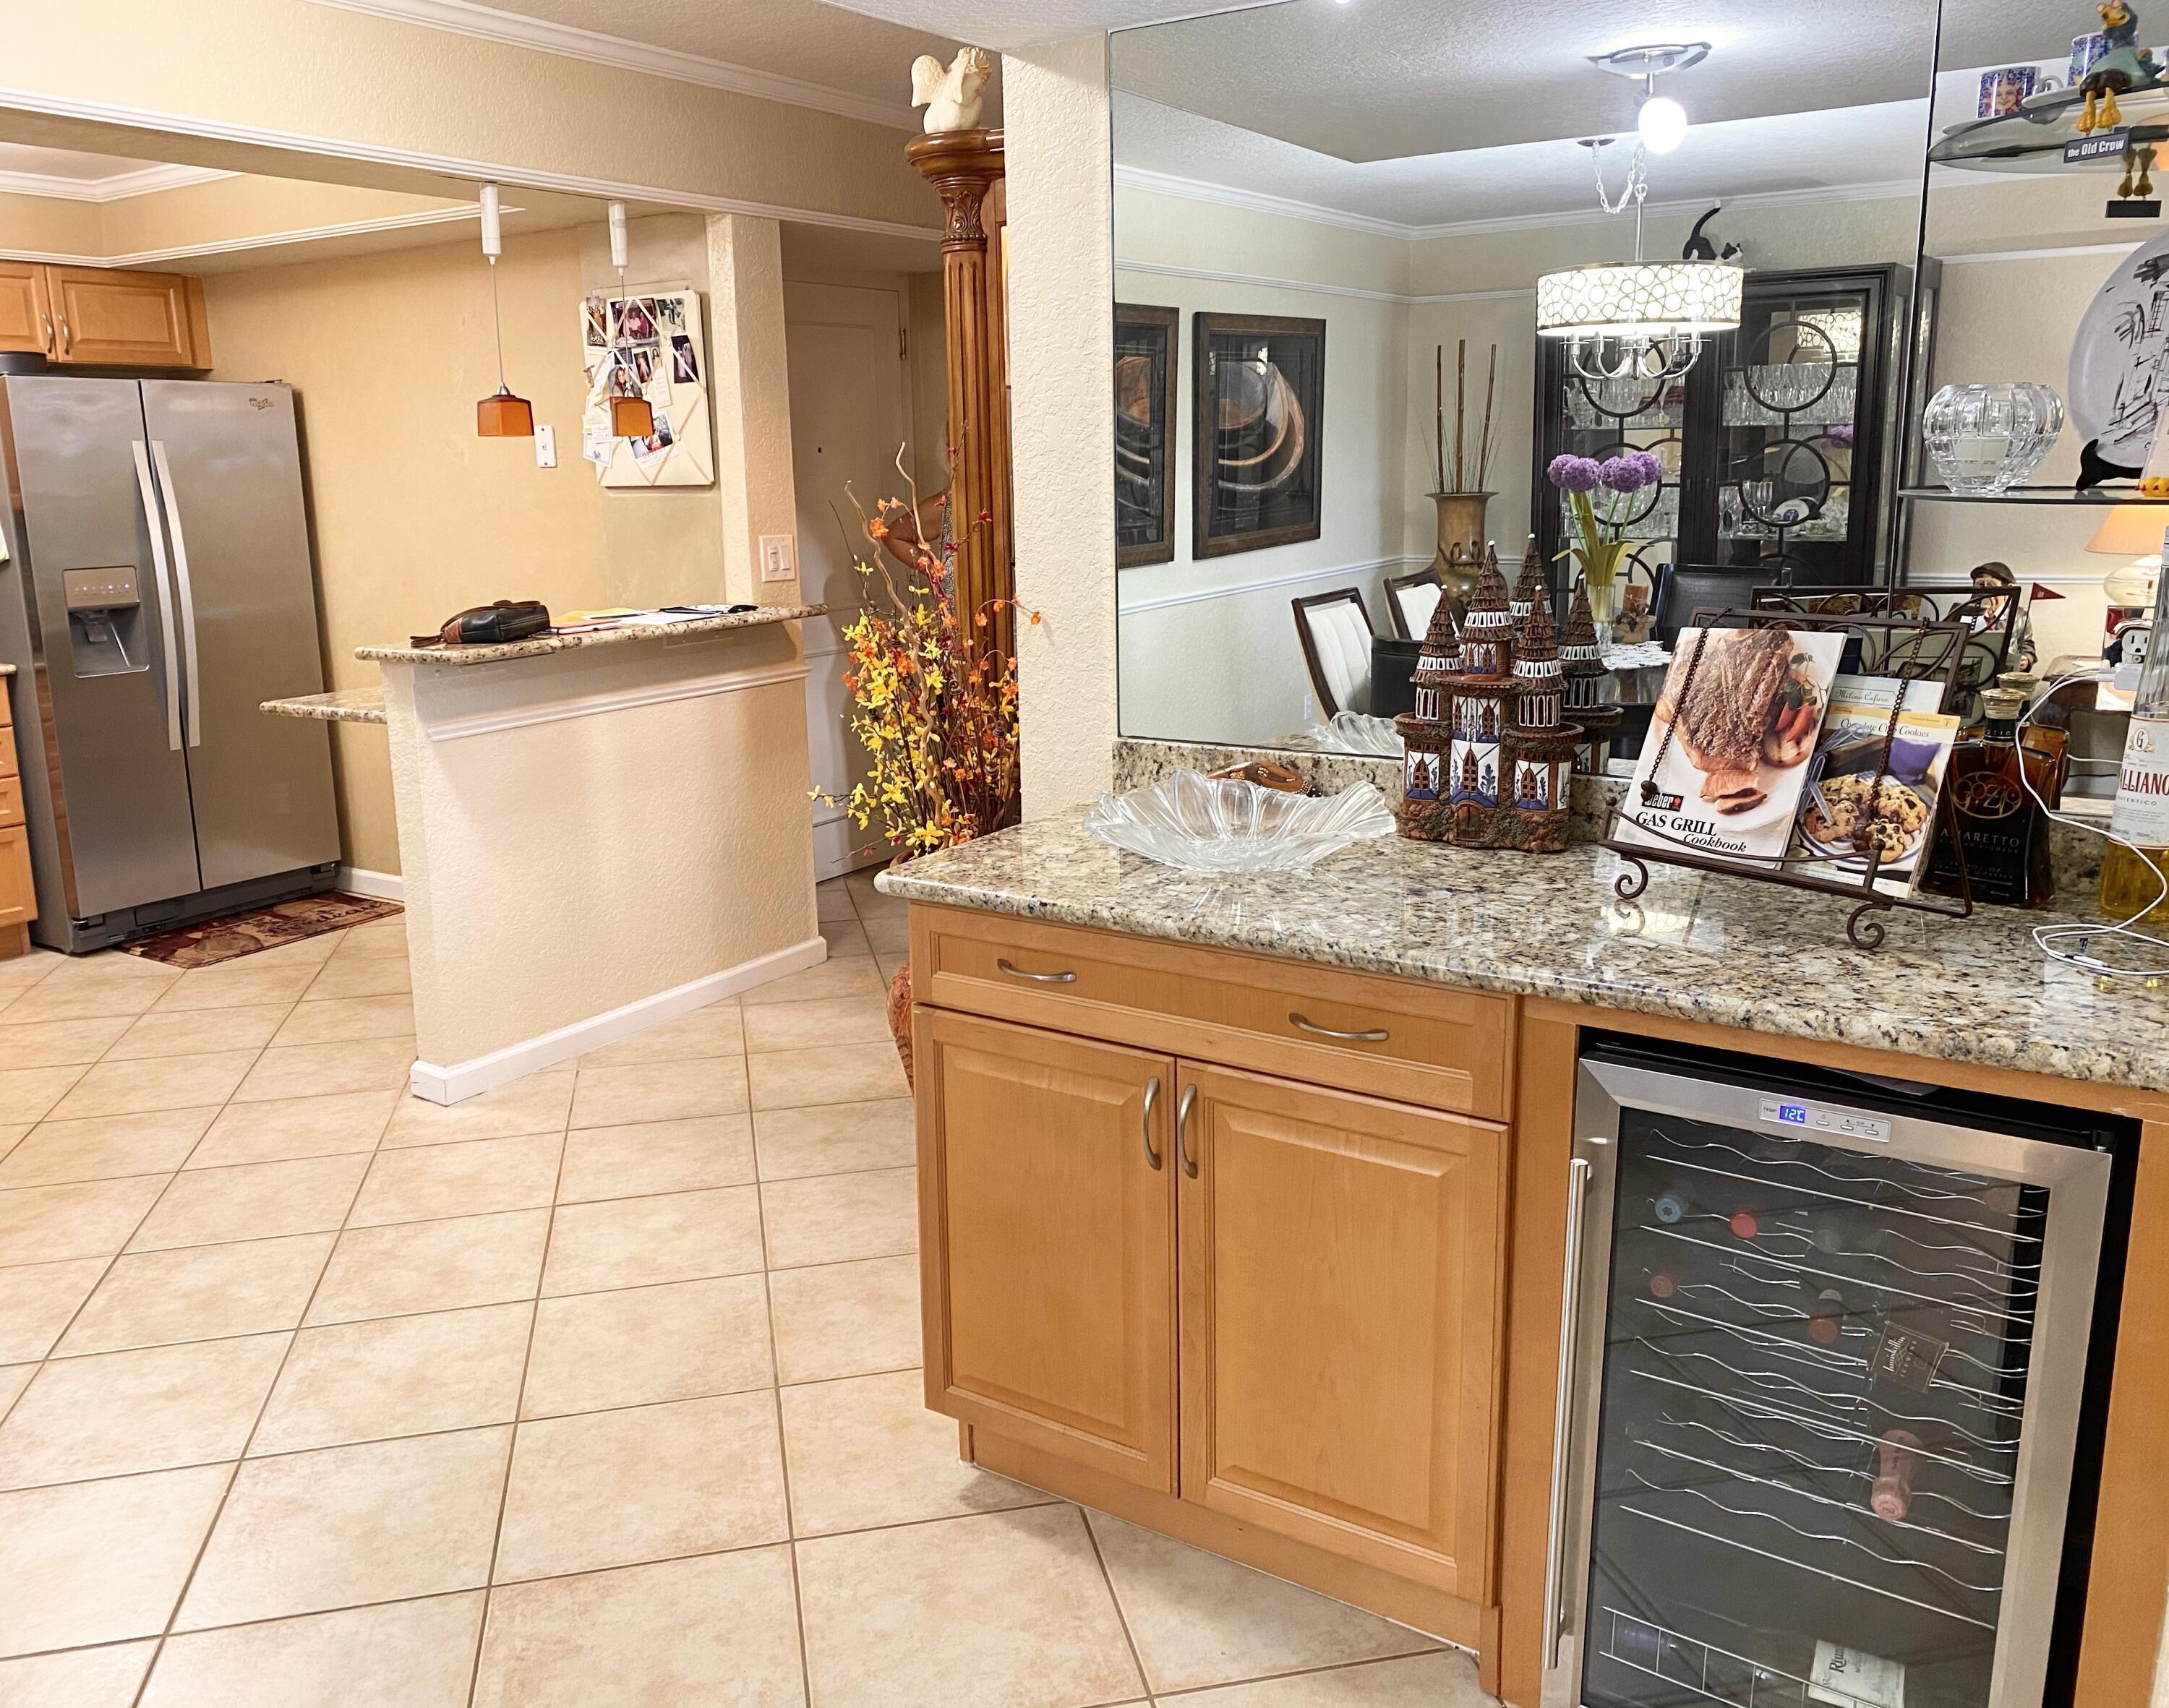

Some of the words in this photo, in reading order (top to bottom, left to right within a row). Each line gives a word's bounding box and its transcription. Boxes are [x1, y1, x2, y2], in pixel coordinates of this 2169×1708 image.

[2068, 149, 2079, 158] the
[2081, 142, 2098, 155] Old
[2098, 140, 2125, 153] Crow
[1899, 726, 1930, 738] Cookies
[1635, 811, 1668, 828] GAS
[1670, 816, 1718, 837] GRILL
[1683, 833, 1747, 853] Cookbook
[1940, 828, 2019, 847] AARETTO
